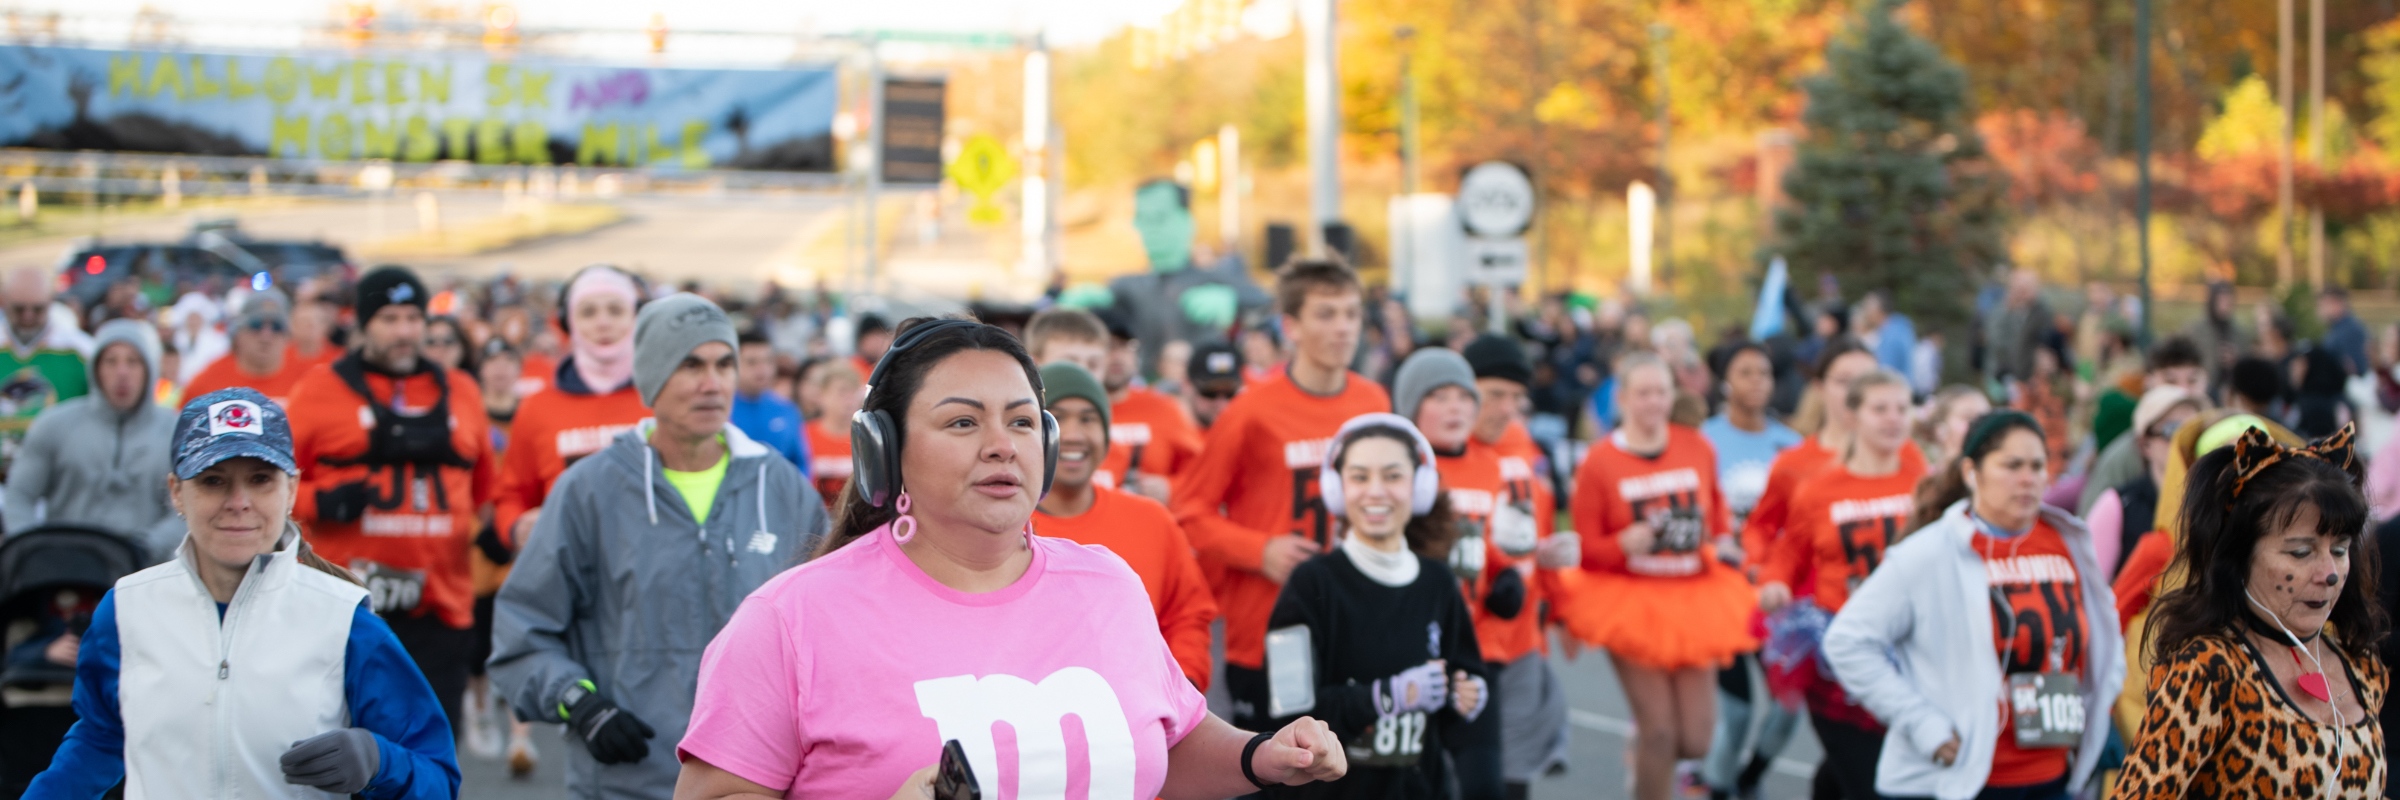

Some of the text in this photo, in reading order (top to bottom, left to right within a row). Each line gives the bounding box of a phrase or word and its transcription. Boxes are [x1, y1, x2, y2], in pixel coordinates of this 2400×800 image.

[108, 54, 648, 112] HALLOWEEN 5K AND
[269, 112, 712, 169] MONSTER MILE
[1374, 710, 1427, 757] 812
